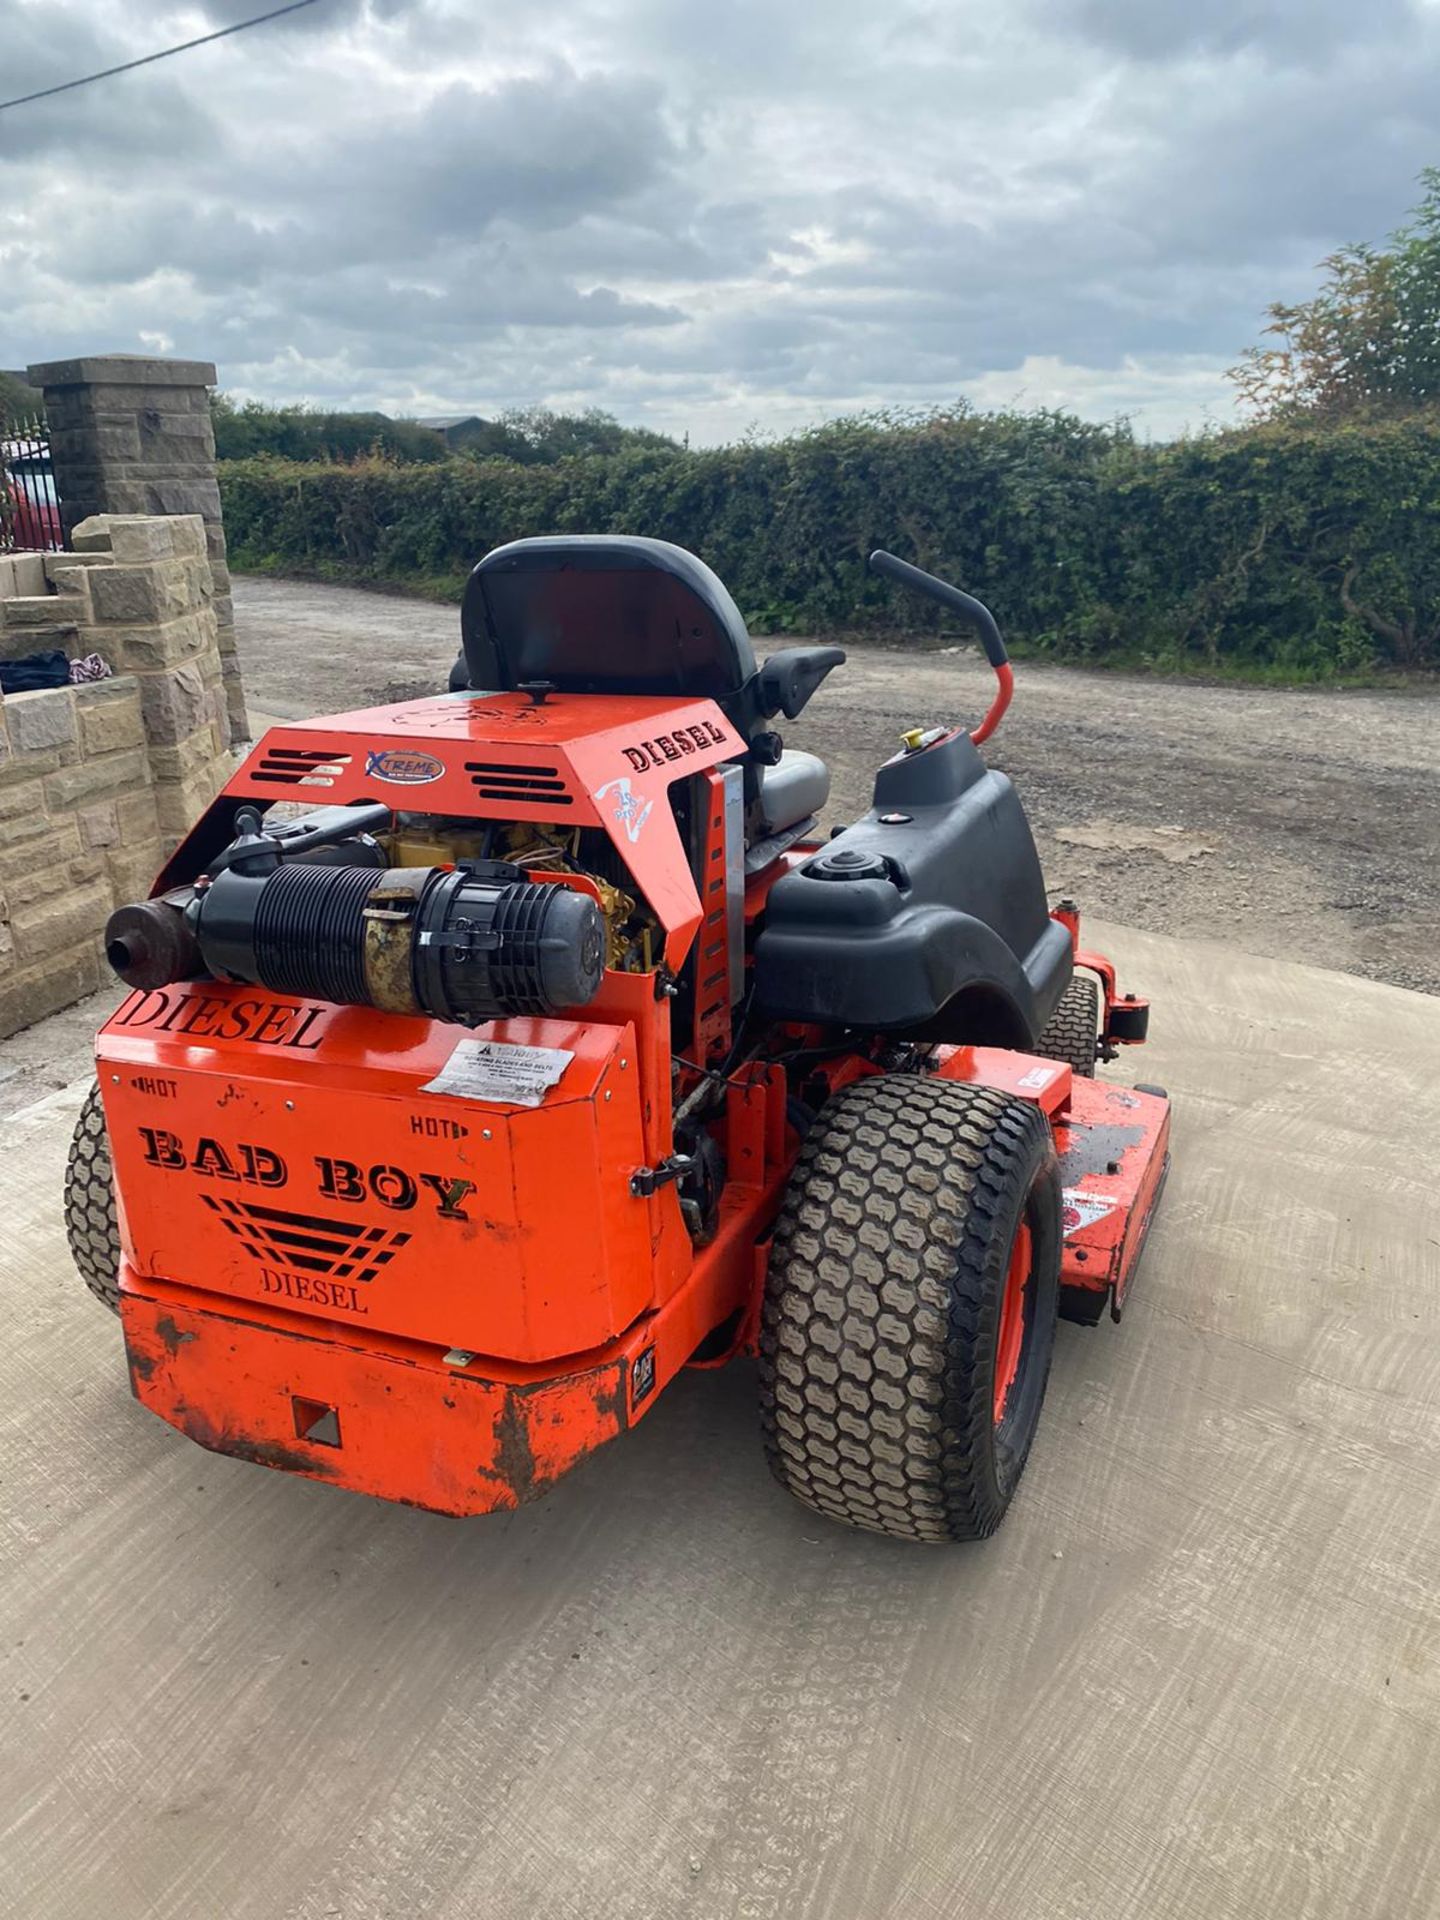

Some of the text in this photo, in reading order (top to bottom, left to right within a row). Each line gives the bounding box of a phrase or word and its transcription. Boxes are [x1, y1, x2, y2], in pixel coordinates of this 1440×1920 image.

[365, 751, 436, 776] XTREME
[621, 721, 727, 773] DIESEL
[116, 991, 327, 1049] DIESEL
[144, 1077, 177, 1098] HOT
[411, 1115, 449, 1138] HOT
[138, 1127, 477, 1224] BAD BOY
[261, 1268, 369, 1314] DIESEL
